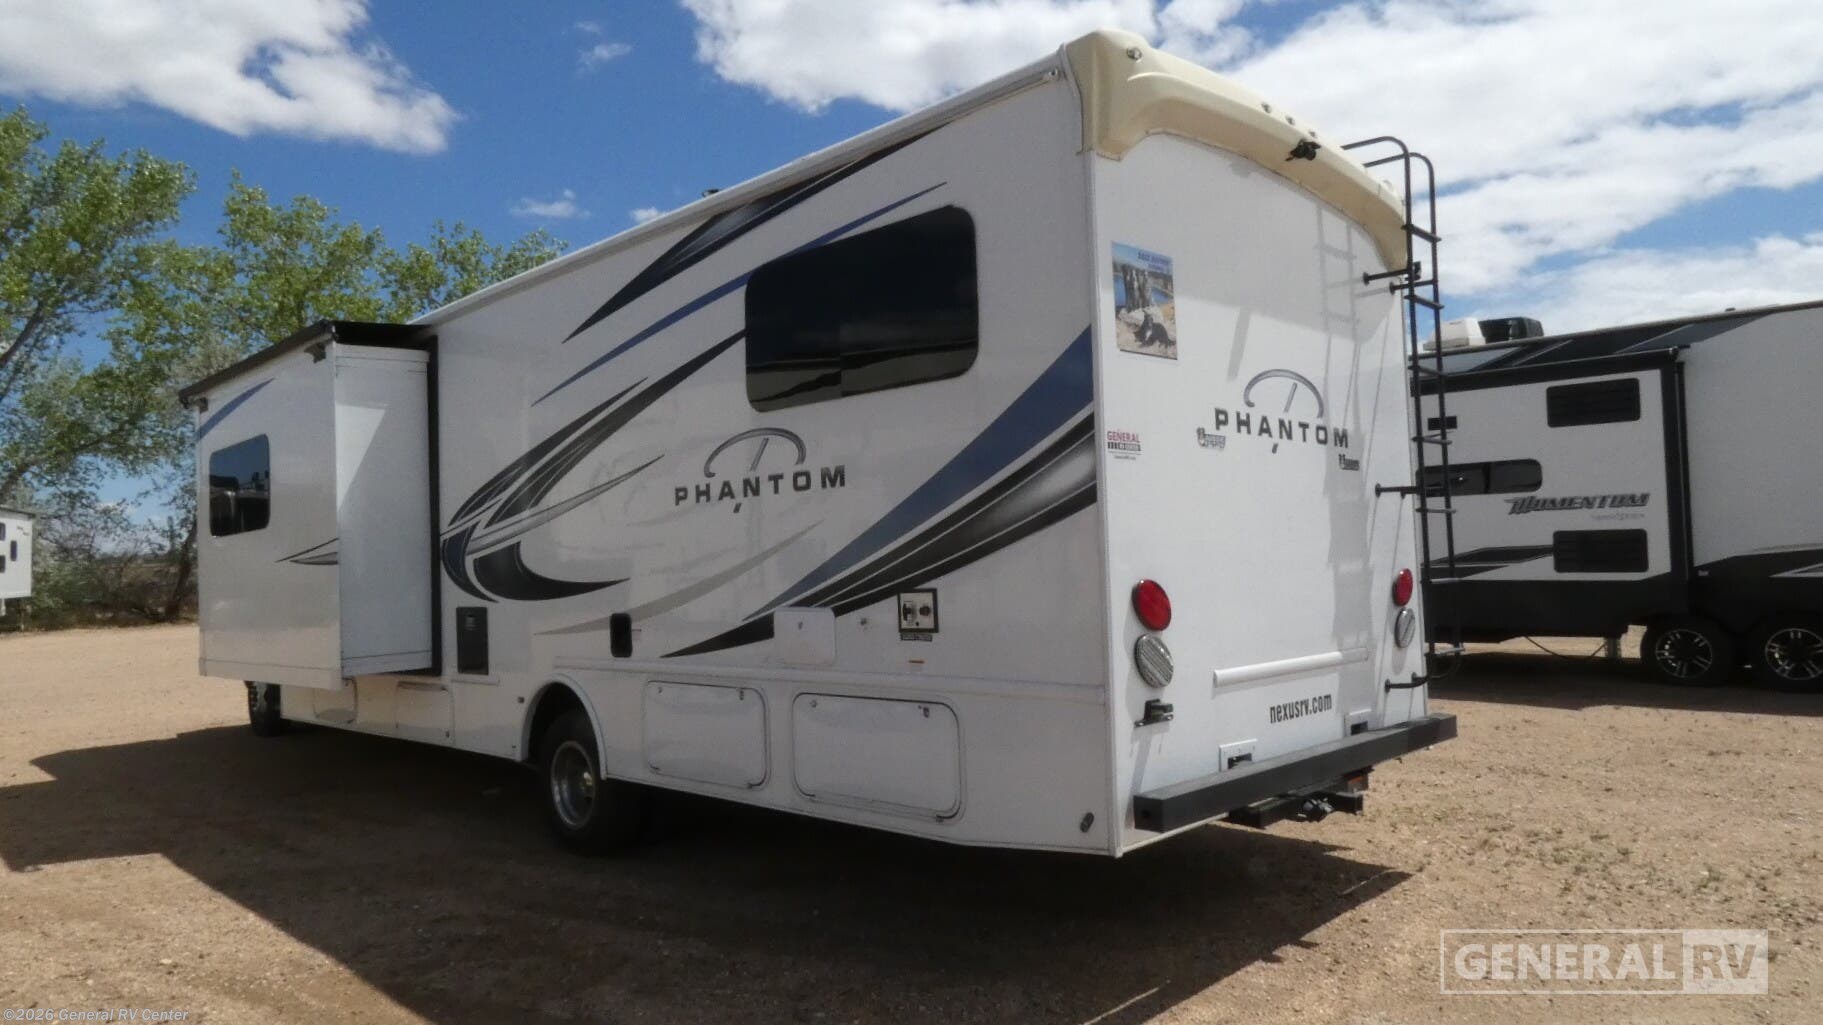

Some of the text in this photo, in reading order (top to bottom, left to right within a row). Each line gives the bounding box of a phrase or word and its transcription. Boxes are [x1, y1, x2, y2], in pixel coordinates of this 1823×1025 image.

[1106, 431, 1141, 443] GENERAL
[1214, 407, 1349, 449] PHANTOM
[674, 464, 846, 507] PHANTOM
[1504, 492, 1651, 515] MOMENTUM
[1270, 693, 1333, 724] nexusrv.com
